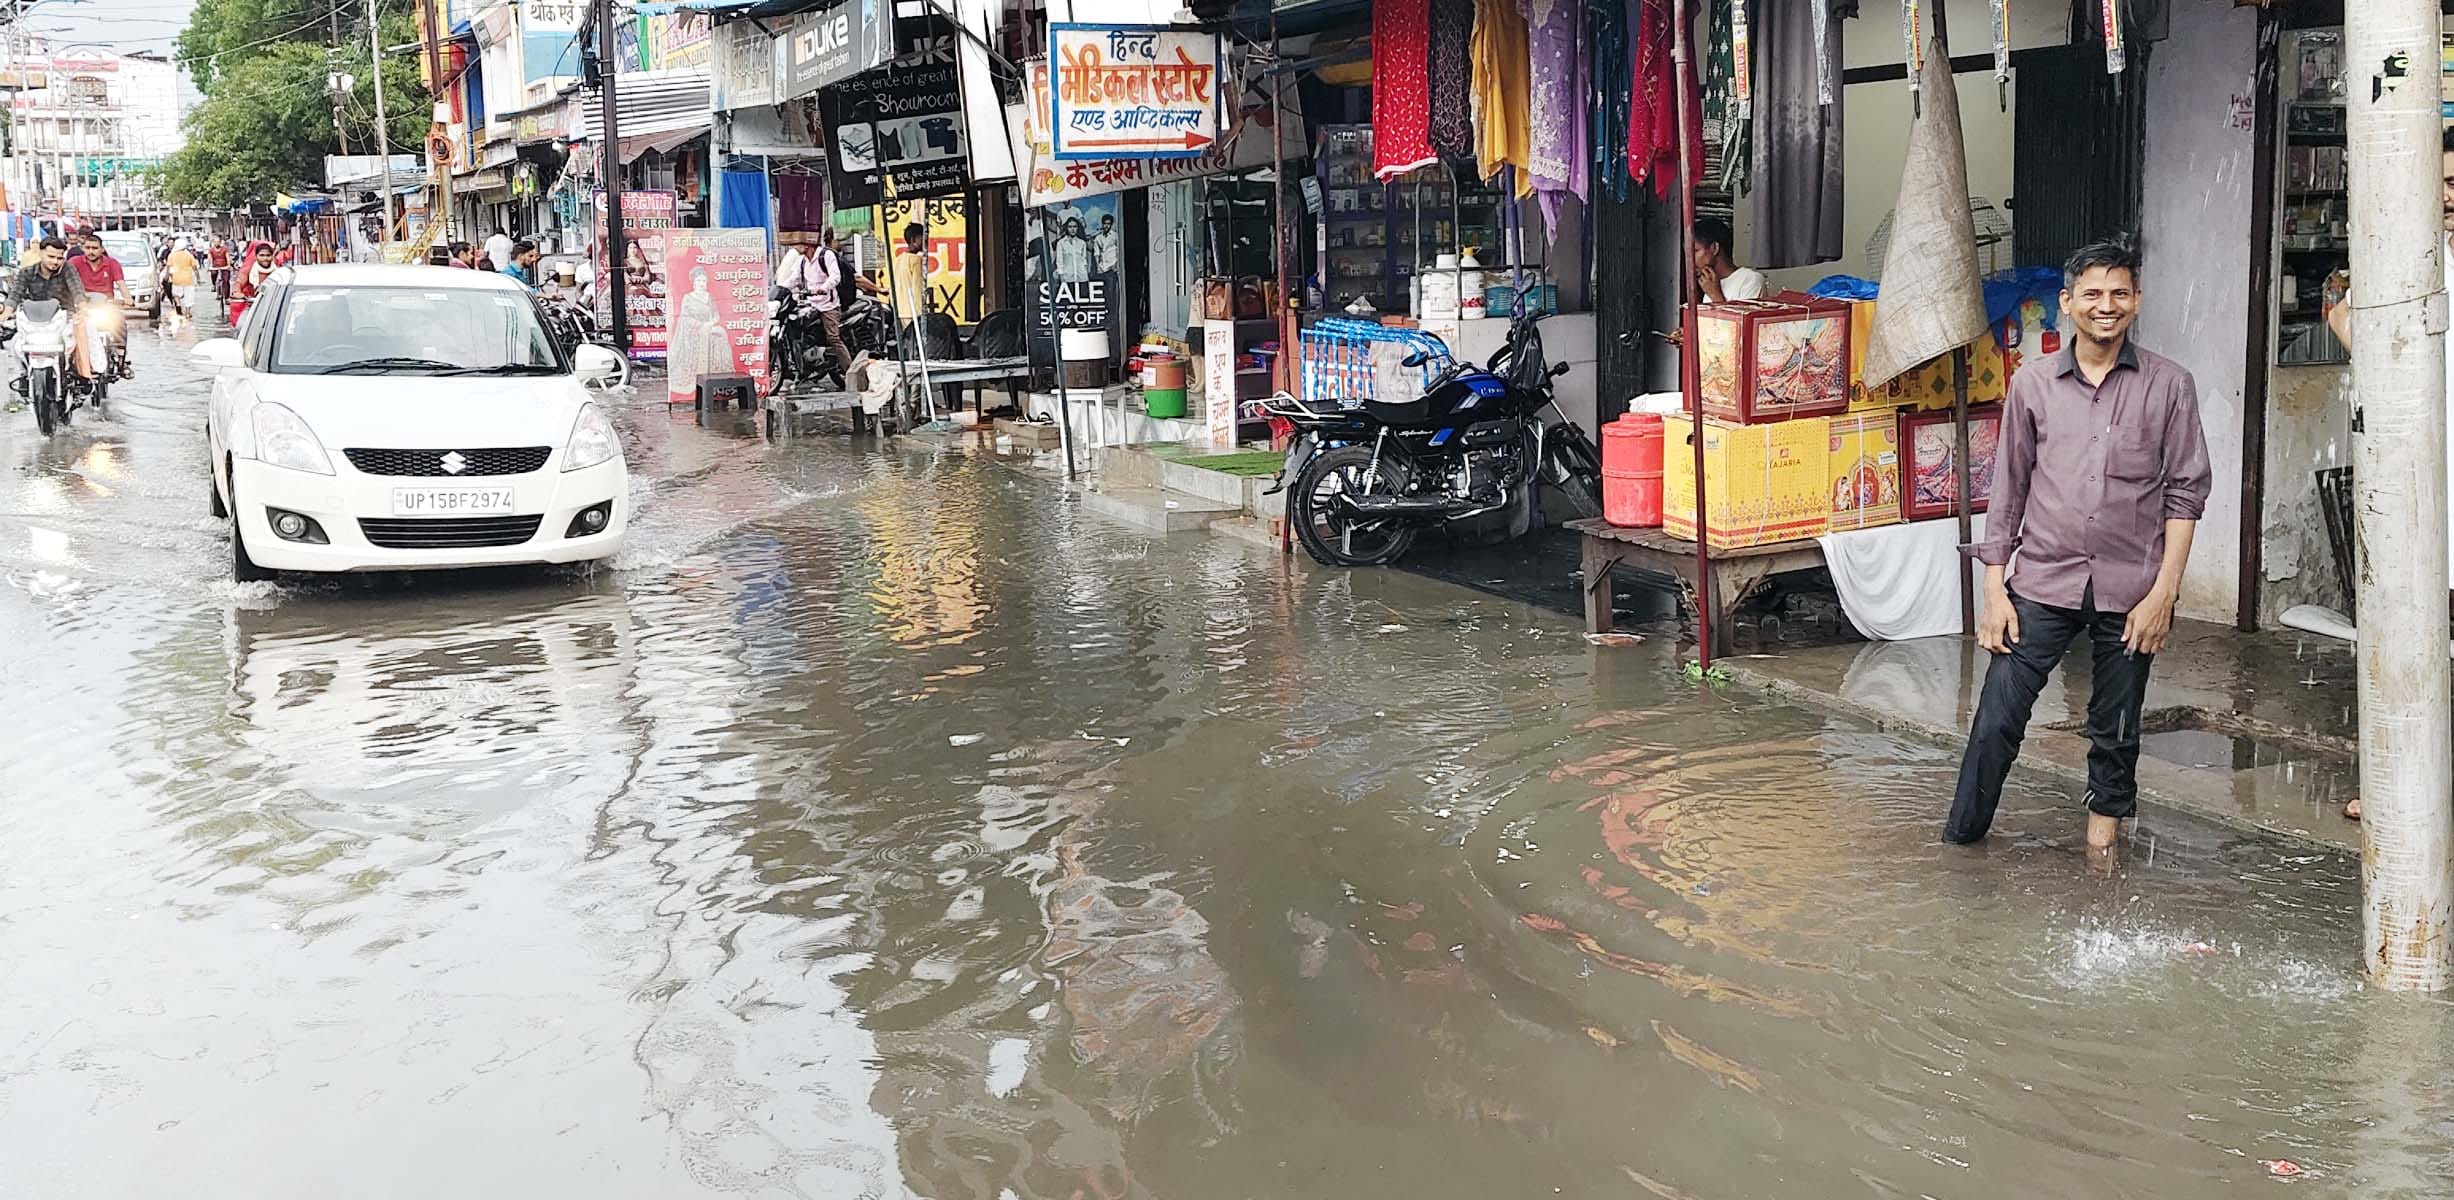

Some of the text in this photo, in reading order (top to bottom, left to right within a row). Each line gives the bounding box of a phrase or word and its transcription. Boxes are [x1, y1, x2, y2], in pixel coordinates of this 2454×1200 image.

[797, 14, 849, 63] DUKE
[1107, 31, 1156, 61] हिन्द
[903, 72, 914, 84] of
[1060, 43, 1150, 105] मेडिकल
[1151, 46, 1213, 105] स्टोर
[873, 92, 959, 115] Showroom
[1039, 281, 1106, 304] SALE
[404, 491, 512, 510] UP15BF2974
